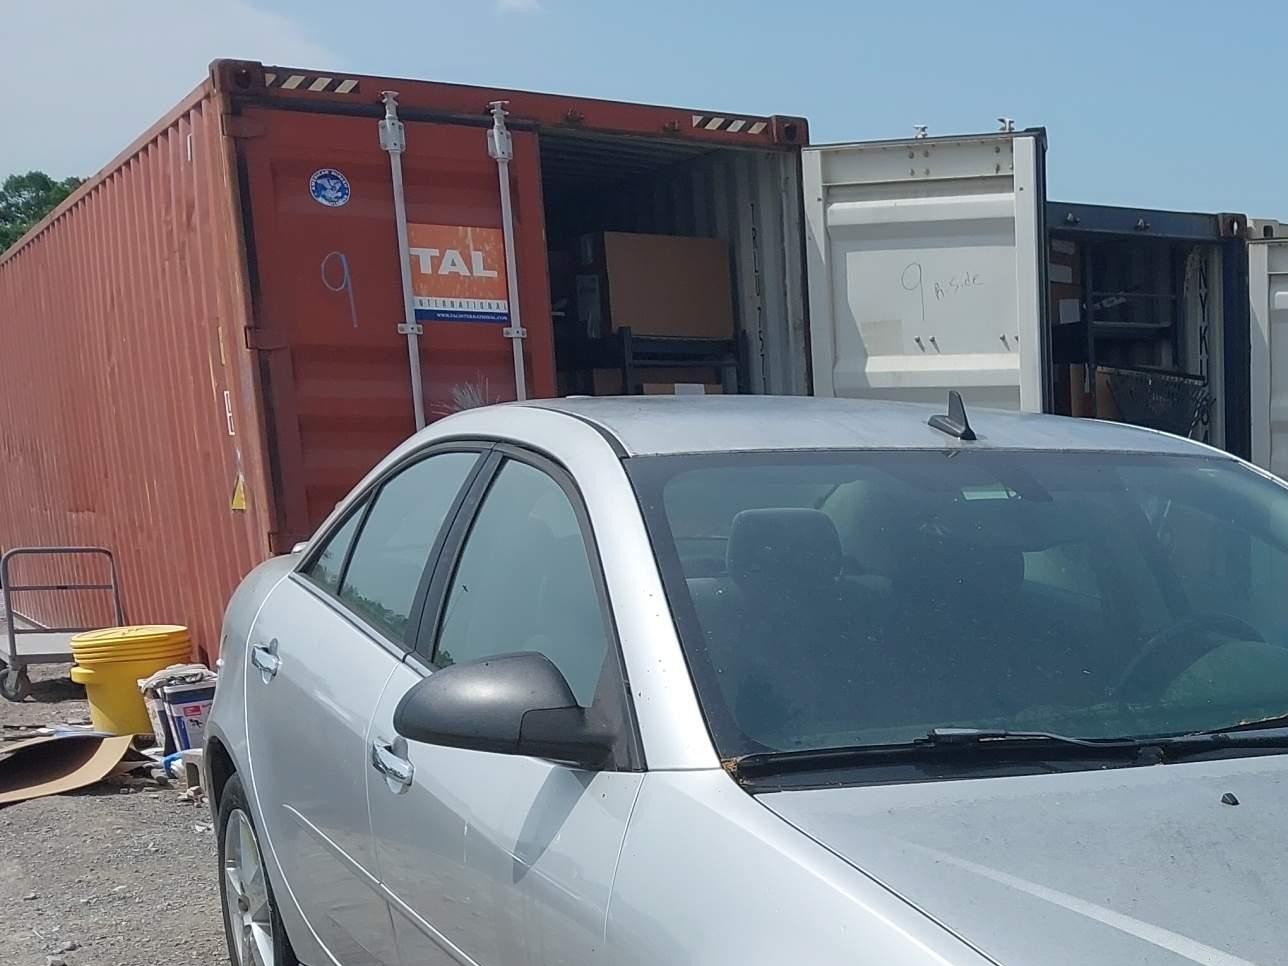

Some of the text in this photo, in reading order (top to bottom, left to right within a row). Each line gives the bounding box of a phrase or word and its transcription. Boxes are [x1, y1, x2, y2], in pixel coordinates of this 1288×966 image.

[410, 248, 498, 278] TAL
[321, 251, 358, 328] 9
[418, 299, 509, 310] NTERNATIONAL
[901, 262, 925, 320] 9
